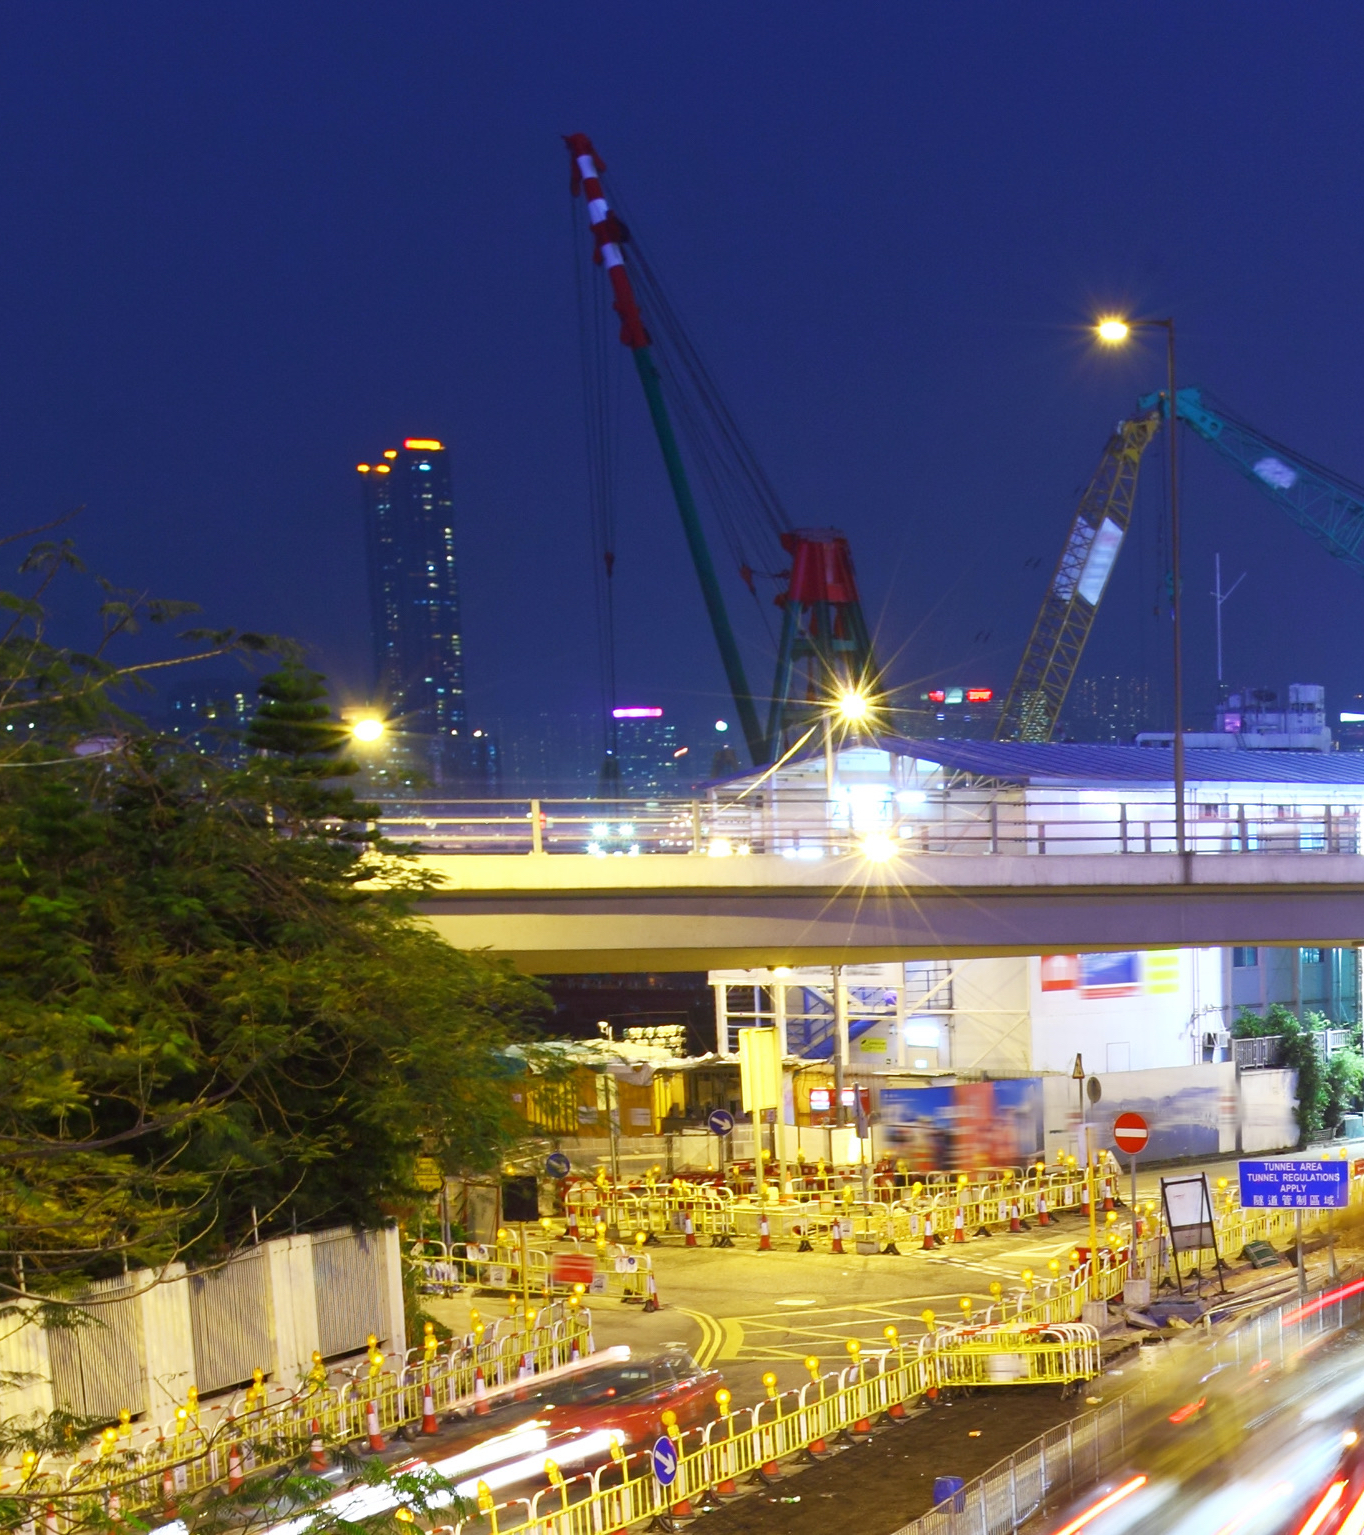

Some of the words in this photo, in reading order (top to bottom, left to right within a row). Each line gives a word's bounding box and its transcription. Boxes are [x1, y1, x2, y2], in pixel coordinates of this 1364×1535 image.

[1263, 1162, 1296, 1171] TUNNEL
[1299, 1162, 1323, 1171] AREA
[1247, 1173, 1279, 1182] TUNNEL
[1282, 1173, 1340, 1182] REGULATIONS
[1280, 1184, 1307, 1193] APPLY
